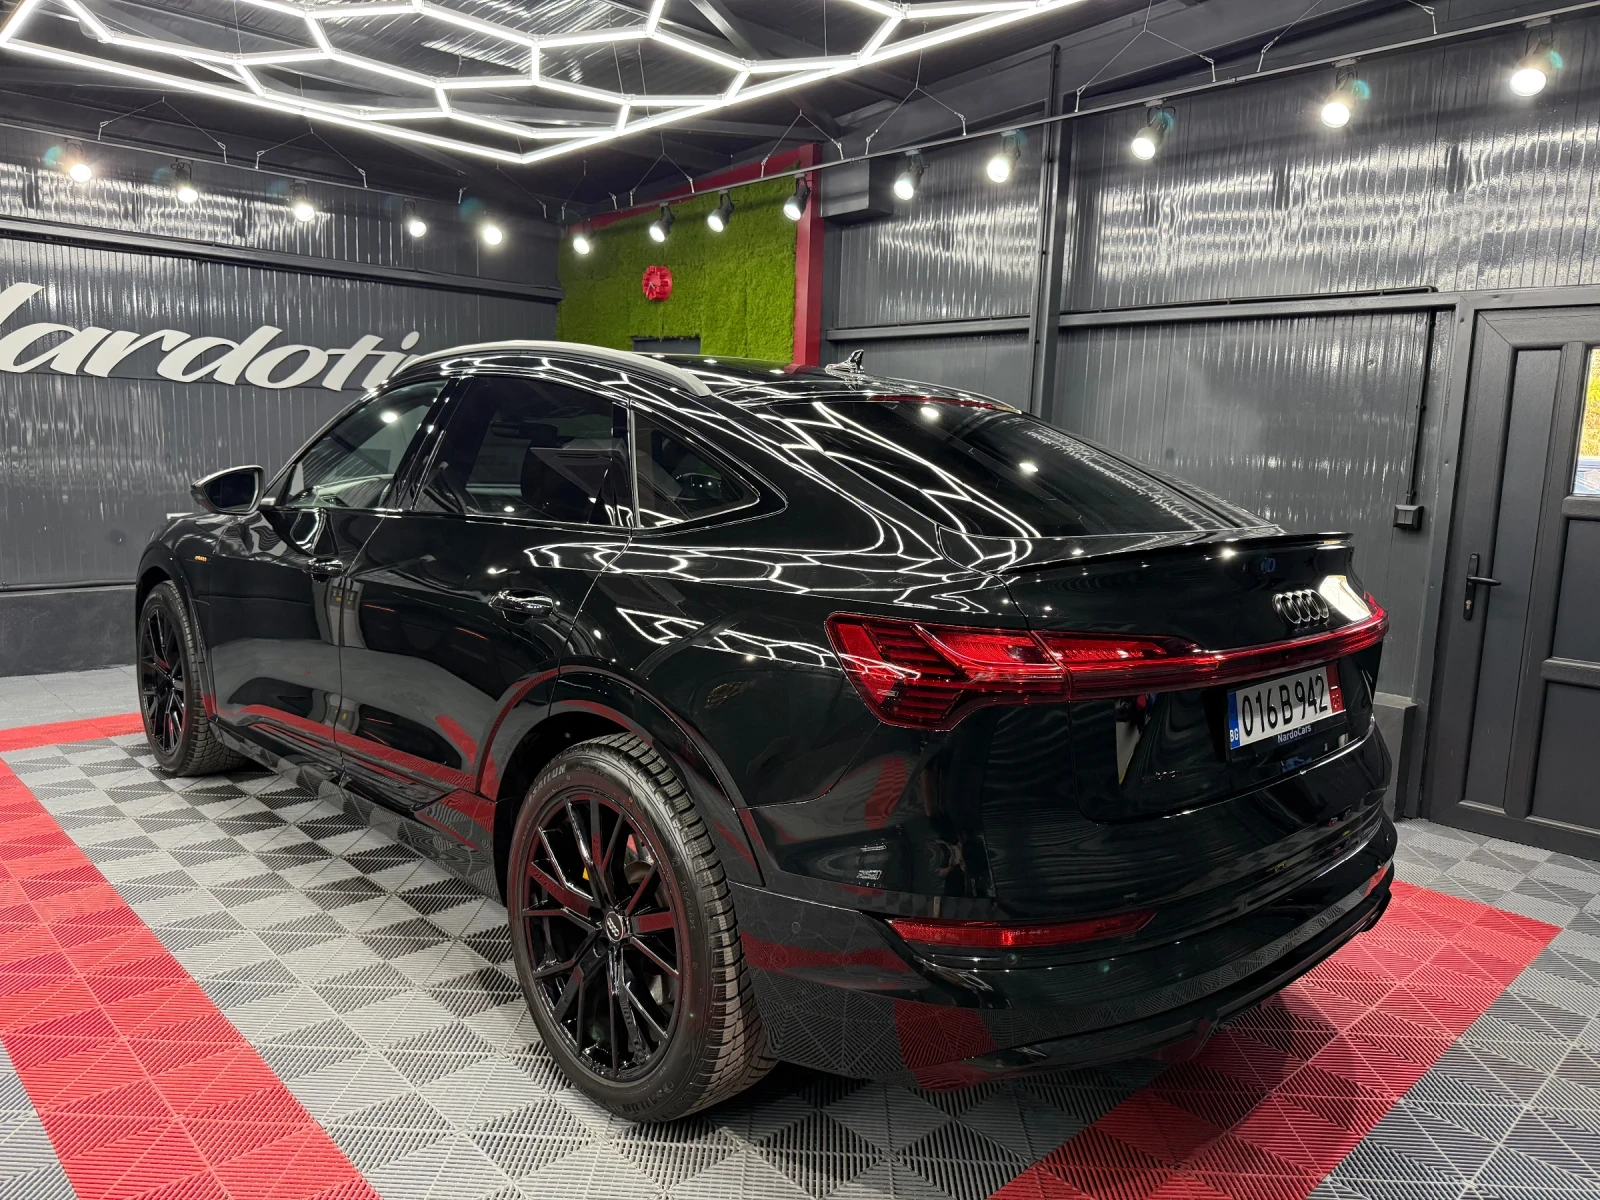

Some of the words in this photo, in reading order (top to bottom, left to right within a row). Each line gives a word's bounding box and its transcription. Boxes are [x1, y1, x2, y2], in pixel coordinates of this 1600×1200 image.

[0, 282, 421, 392] ardoti
[1229, 727, 1239, 743] BG
[1277, 723, 1312, 744] NardoCars
[532, 763, 567, 798] SAILUN
